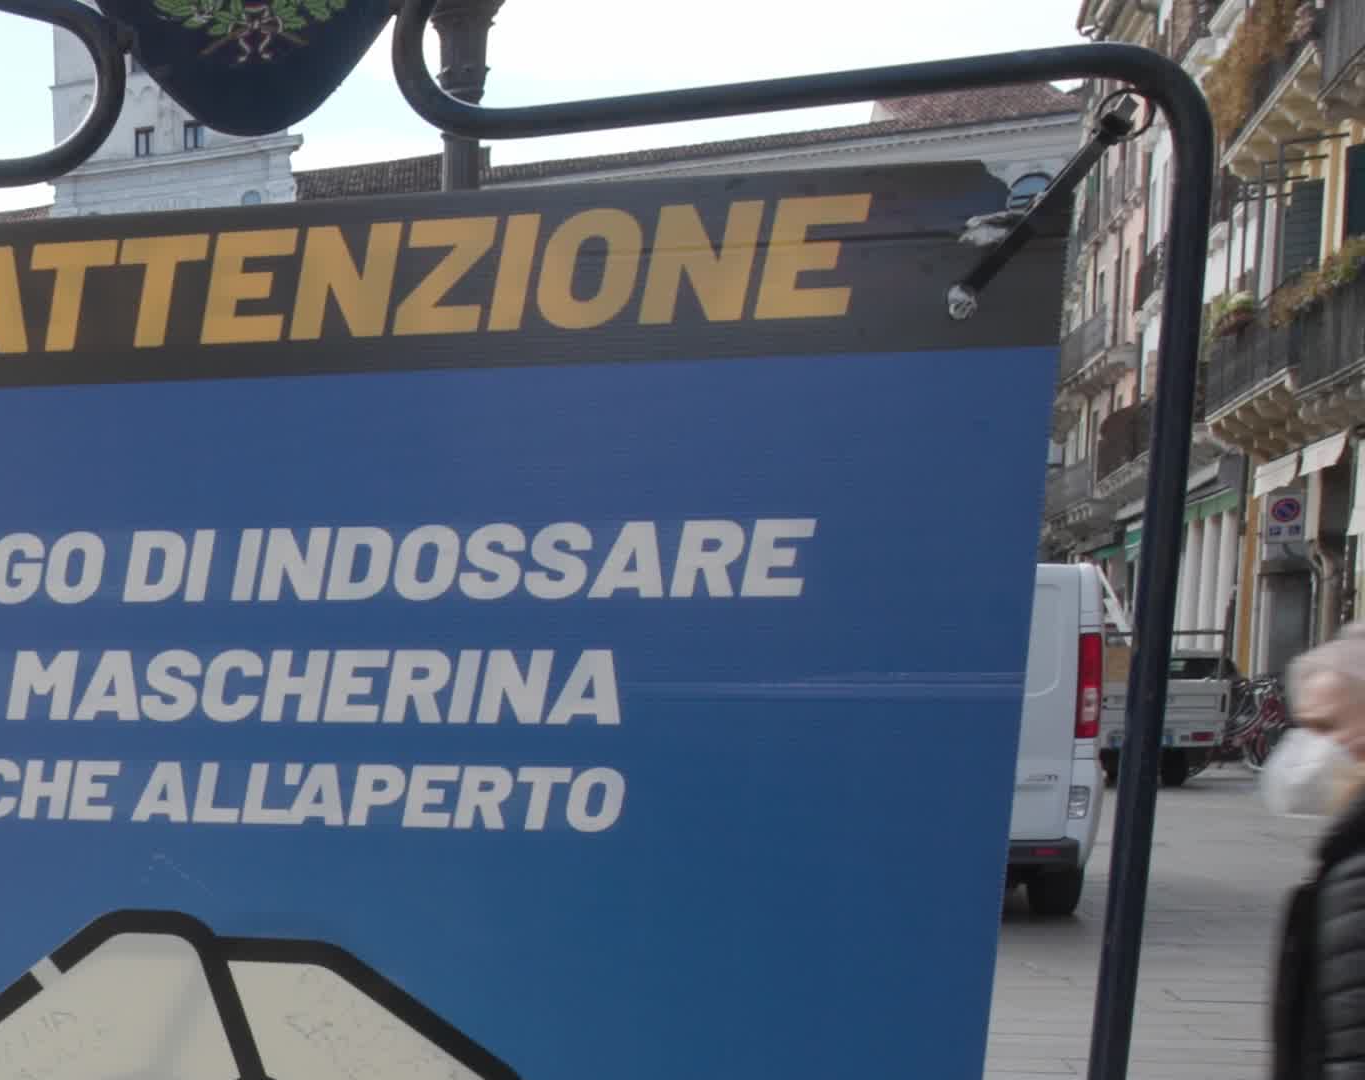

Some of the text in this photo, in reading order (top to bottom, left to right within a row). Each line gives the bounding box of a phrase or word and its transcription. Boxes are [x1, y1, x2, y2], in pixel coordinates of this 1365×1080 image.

[122, 529, 216, 603] DI
[230, 518, 816, 602] INDOSSARE
[5, 649, 620, 725] MASCHERINA
[131, 761, 625, 833] ALL'APERTO
